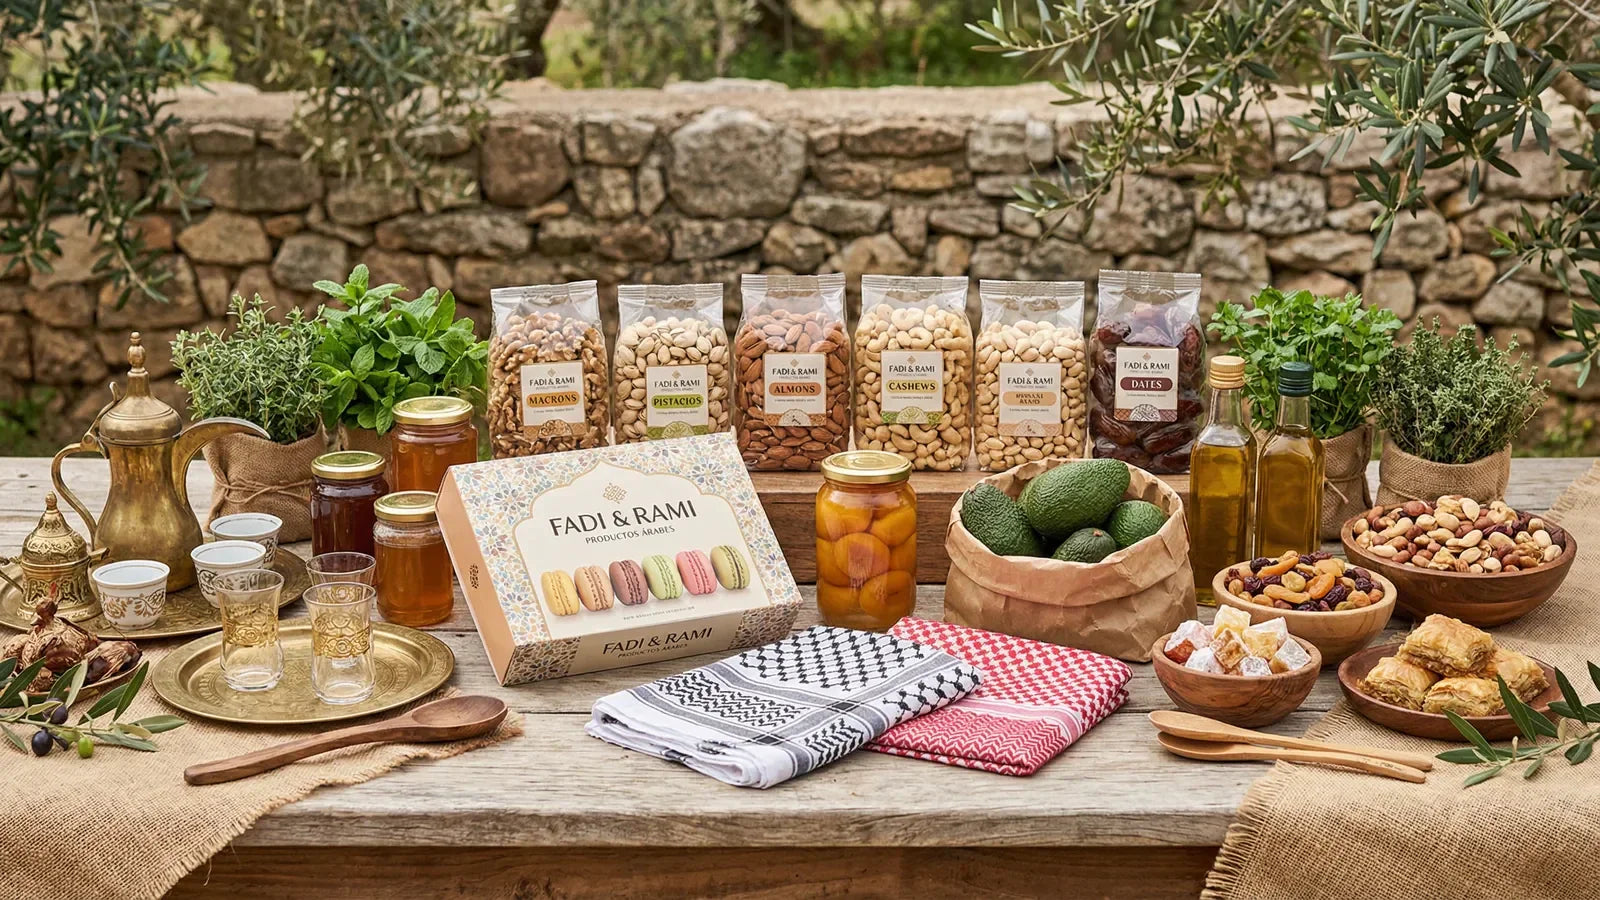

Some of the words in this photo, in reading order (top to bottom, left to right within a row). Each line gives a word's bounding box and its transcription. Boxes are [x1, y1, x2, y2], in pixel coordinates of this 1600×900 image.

[1142, 362, 1149, 370] &
[1149, 362, 1170, 370] RAMI
[529, 378, 547, 386] FADI
[555, 376, 575, 384] RAMI
[654, 380, 672, 388] FADI
[1007, 377, 1025, 385] FADI
[1026, 377, 1032, 385] &
[1033, 377, 1053, 385] RAMI
[1131, 380, 1162, 389] DATES
[774, 385, 816, 394] ALMONS
[888, 382, 936, 391] CASHEWS
[529, 394, 577, 405] MACRONS
[653, 396, 702, 407] PISTACIOS
[549, 512, 607, 536] FADI
[612, 510, 631, 527] &
[632, 500, 697, 524] RAMI
[585, 530, 640, 545] PRODUCTOS
[641, 525, 676, 537] ÁRABES
[602, 638, 645, 655] FADI
[647, 635, 661, 647] &
[665, 627, 713, 645] RAMI
